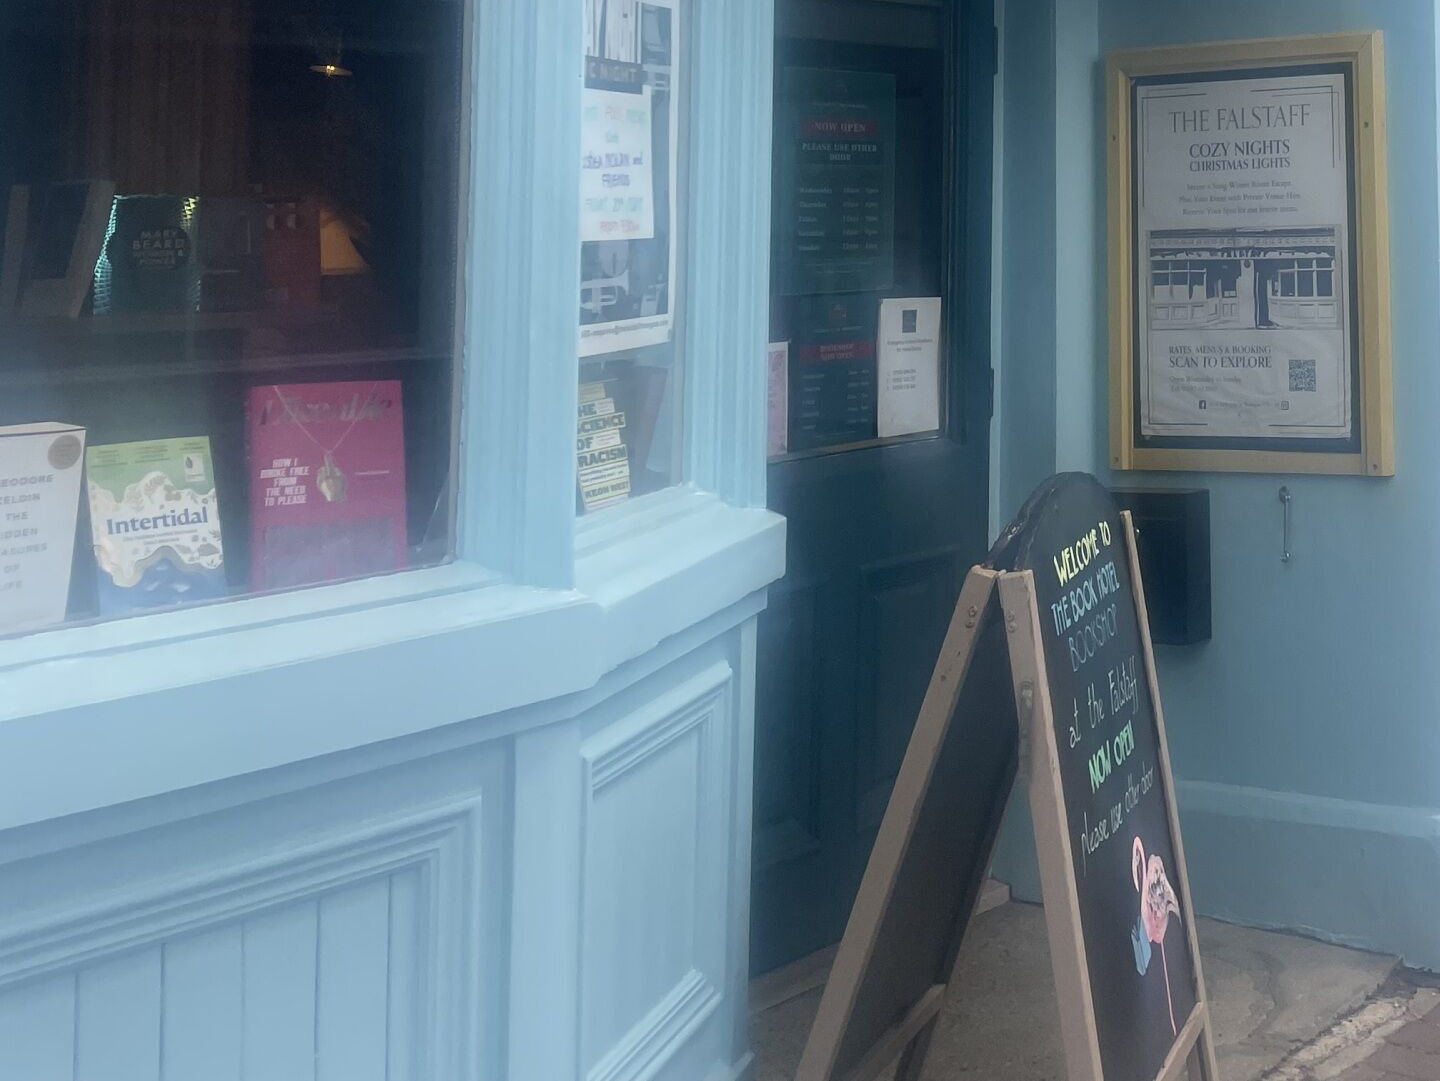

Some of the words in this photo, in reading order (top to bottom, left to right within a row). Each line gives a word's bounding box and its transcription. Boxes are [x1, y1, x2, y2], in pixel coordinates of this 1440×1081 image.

[1168, 109, 1210, 133] THE
[1215, 103, 1311, 131] FALSTAFF
[1189, 142, 1229, 159] COZY
[1234, 138, 1290, 157] NIGHTS
[1189, 158, 1249, 172] CHRISTMAS
[1251, 156, 1291, 170] LIGHTS
[132, 239, 185, 250] BEARD
[1232, 345, 1271, 355] BOOKING
[1169, 356, 1199, 369] SCAN
[1202, 356, 1218, 368] TO
[1220, 355, 1272, 369] EXPLORE
[576, 436, 594, 451] OF
[577, 445, 627, 468] RACISM
[264, 496, 275, 507] TO
[277, 494, 308, 506] PLEASE
[266, 487, 281, 497] THE
[284, 485, 307, 496] NEED
[5, 511, 29, 521] THE
[106, 506, 209, 536] Intertidal
[1053, 528, 1100, 588] WELCOME
[1099, 520, 1112, 547] TO
[1051, 595, 1072, 636] THE
[1070, 576, 1098, 623] BOOK
[1096, 560, 1121, 601] HOTEL
[1068, 603, 1119, 673] BOOKSHOP
[1069, 697, 1082, 749] at
[1087, 682, 1105, 729] the
[1107, 655, 1139, 716] Falstaff
[1088, 740, 1112, 795] NOW
[1113, 719, 1135, 767] OPEN
[1080, 811, 1110, 879] please
[1110, 801, 1123, 835] use
[1124, 773, 1140, 814] other
[1140, 760, 1154, 796] door
